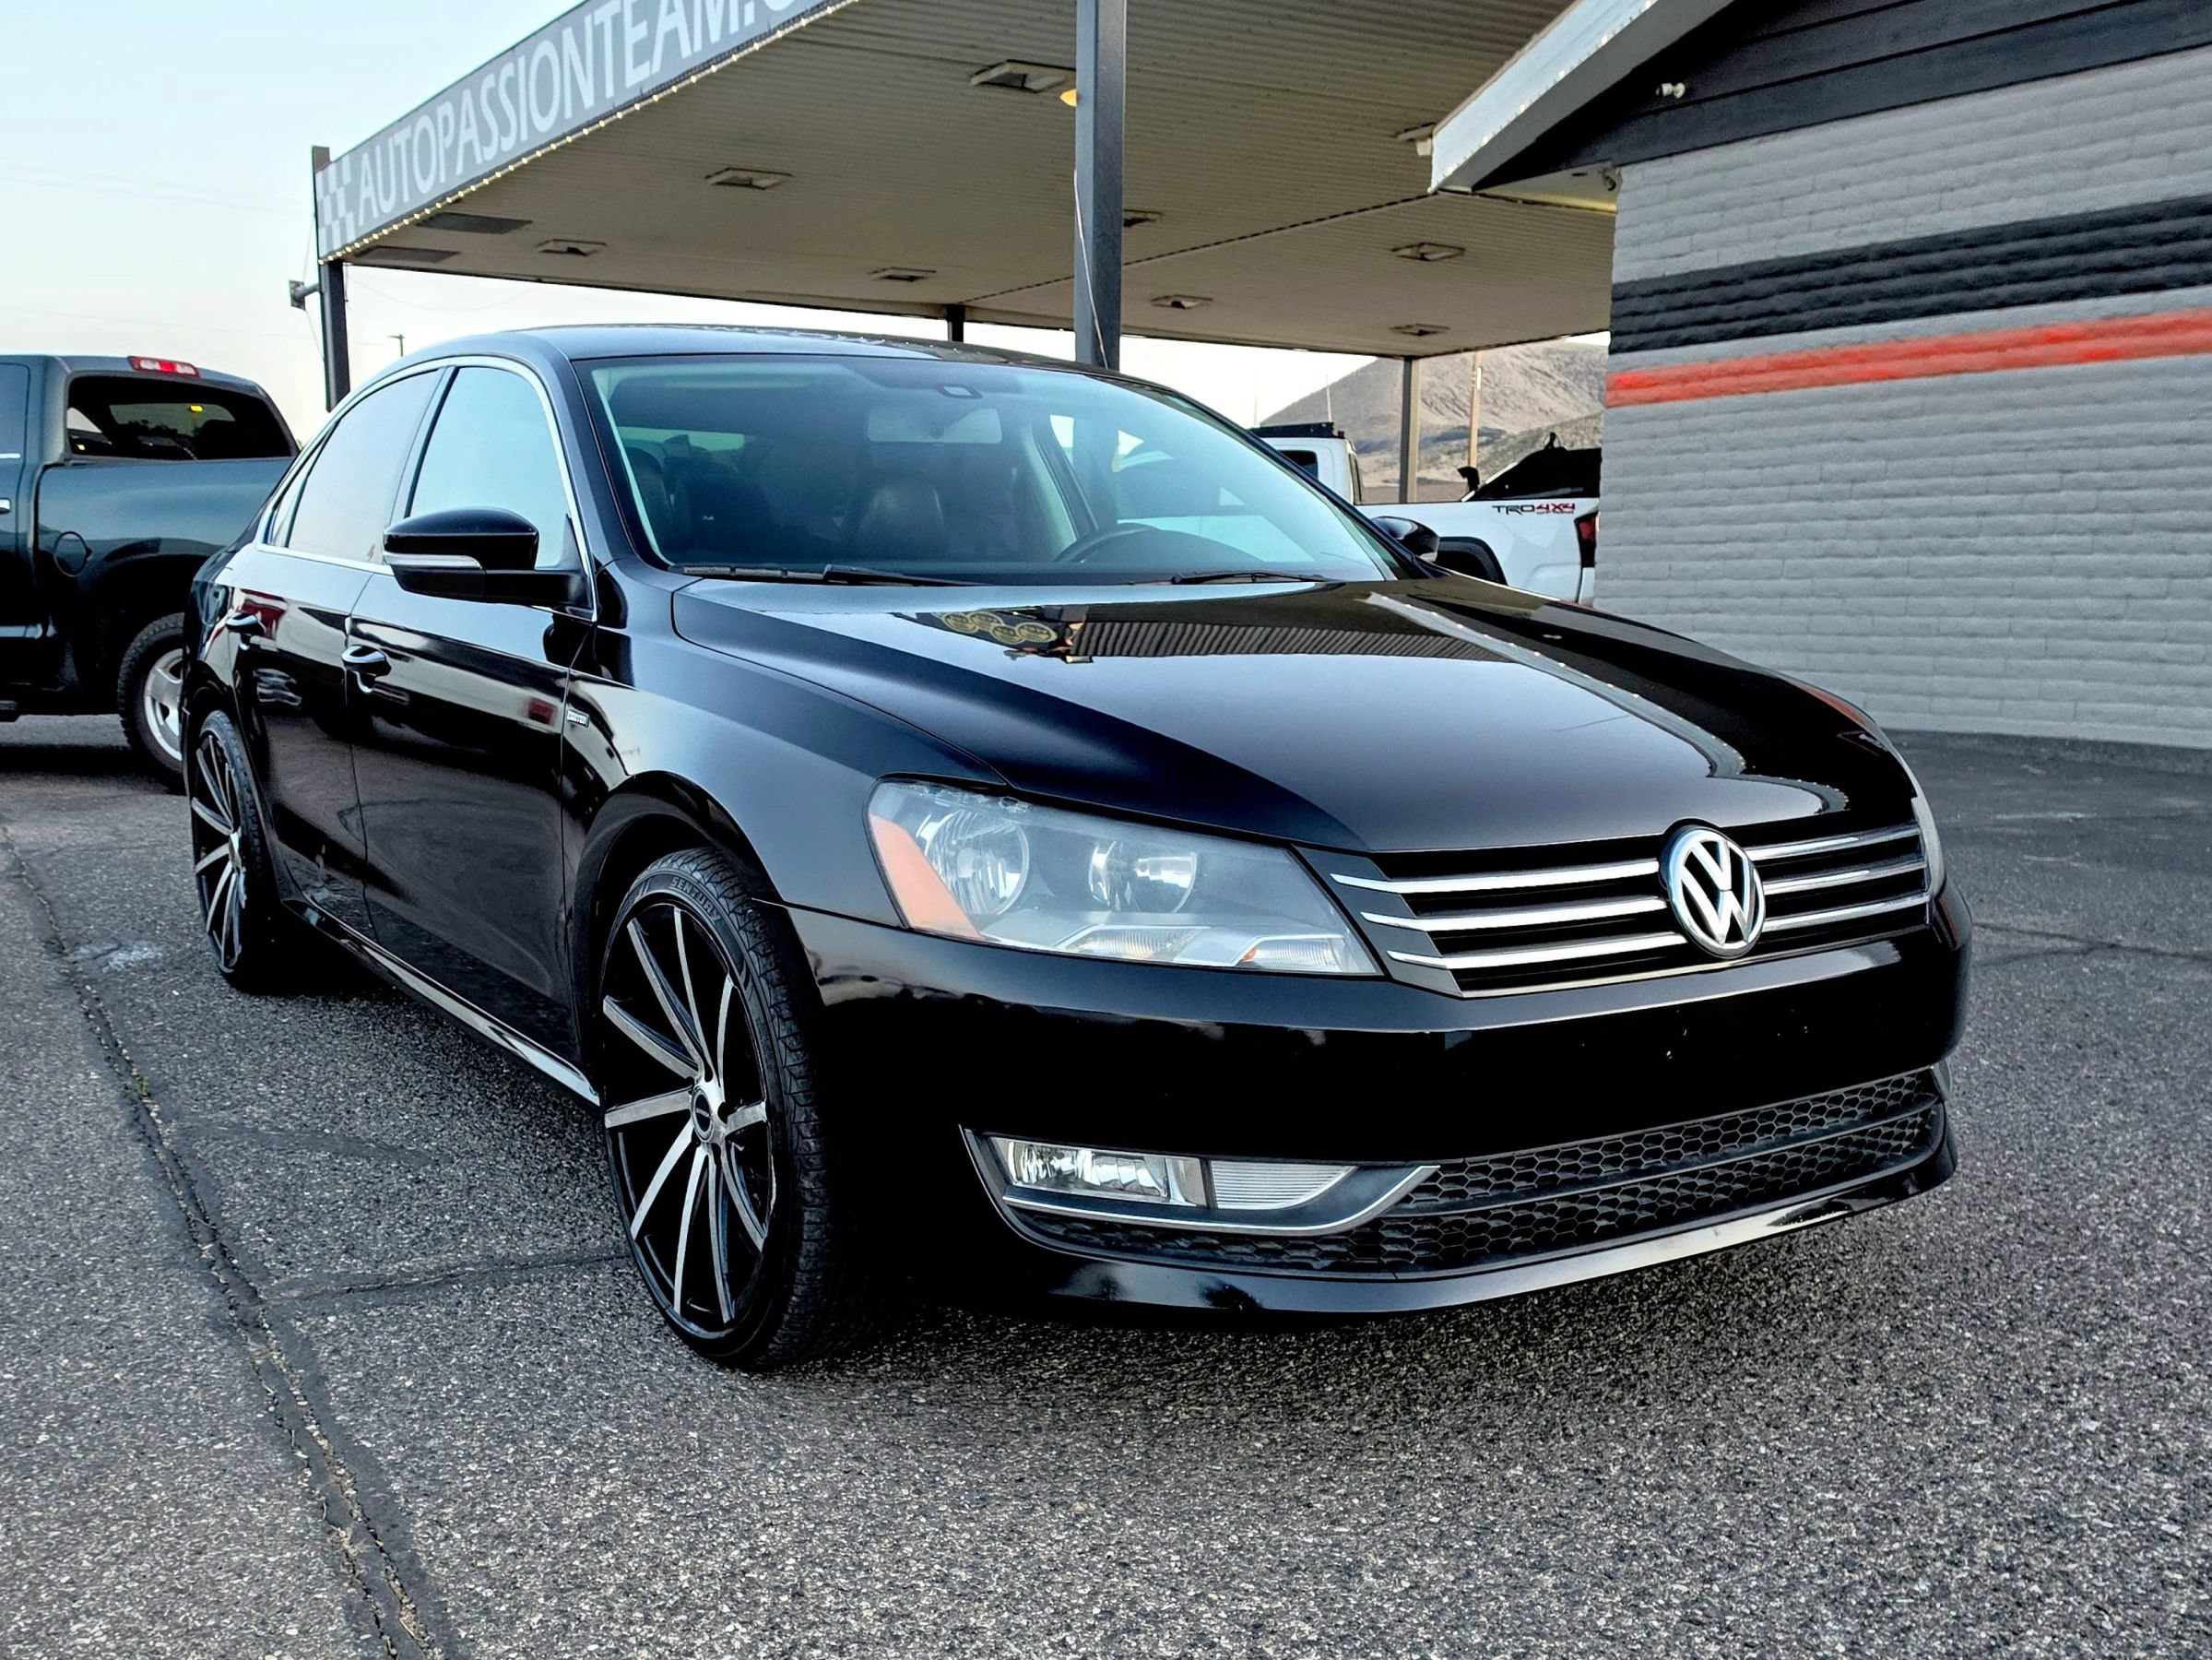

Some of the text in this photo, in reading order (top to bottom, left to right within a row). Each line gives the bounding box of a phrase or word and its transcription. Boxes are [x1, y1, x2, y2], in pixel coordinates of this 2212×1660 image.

[358, 0, 793, 227] AUTOPASSIONTEAM.
[670, 876, 721, 921] SENTURY
[1670, 829, 1763, 953] VW
